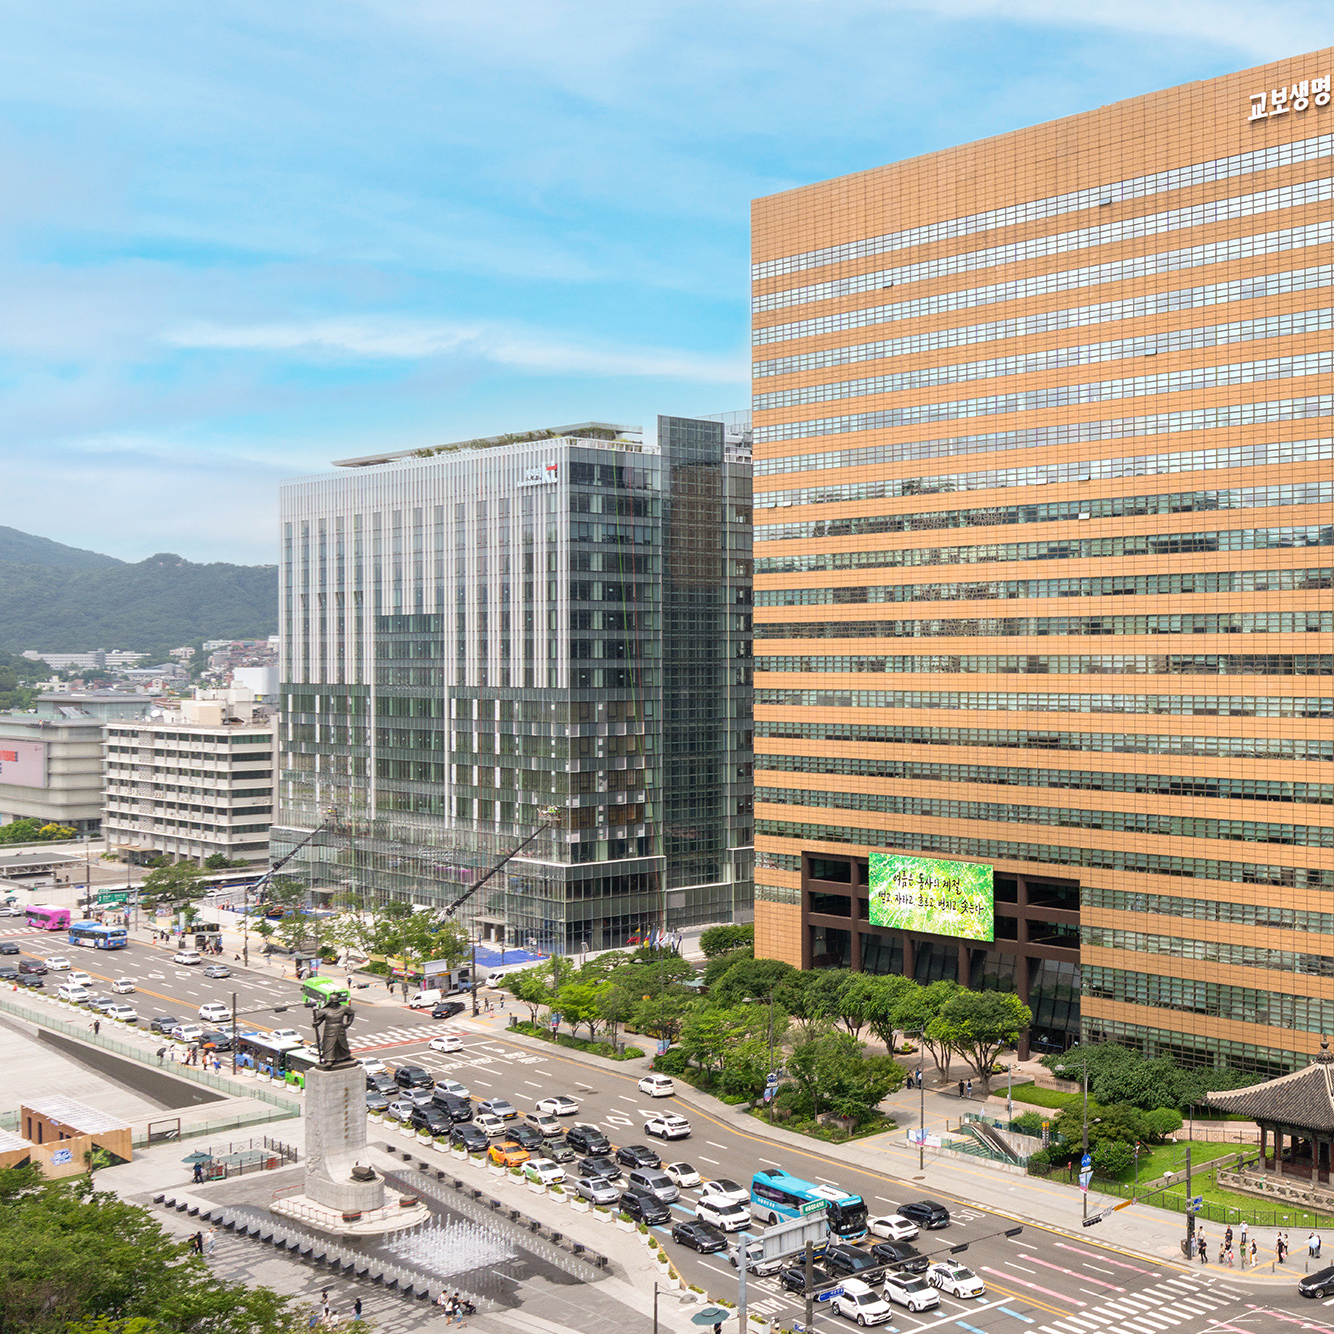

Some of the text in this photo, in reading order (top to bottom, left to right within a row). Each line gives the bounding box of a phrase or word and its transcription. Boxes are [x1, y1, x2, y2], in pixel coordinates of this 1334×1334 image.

[1248, 75, 1331, 121] 교보생명
[892, 870, 962, 895] 여름은 동사의 계절
